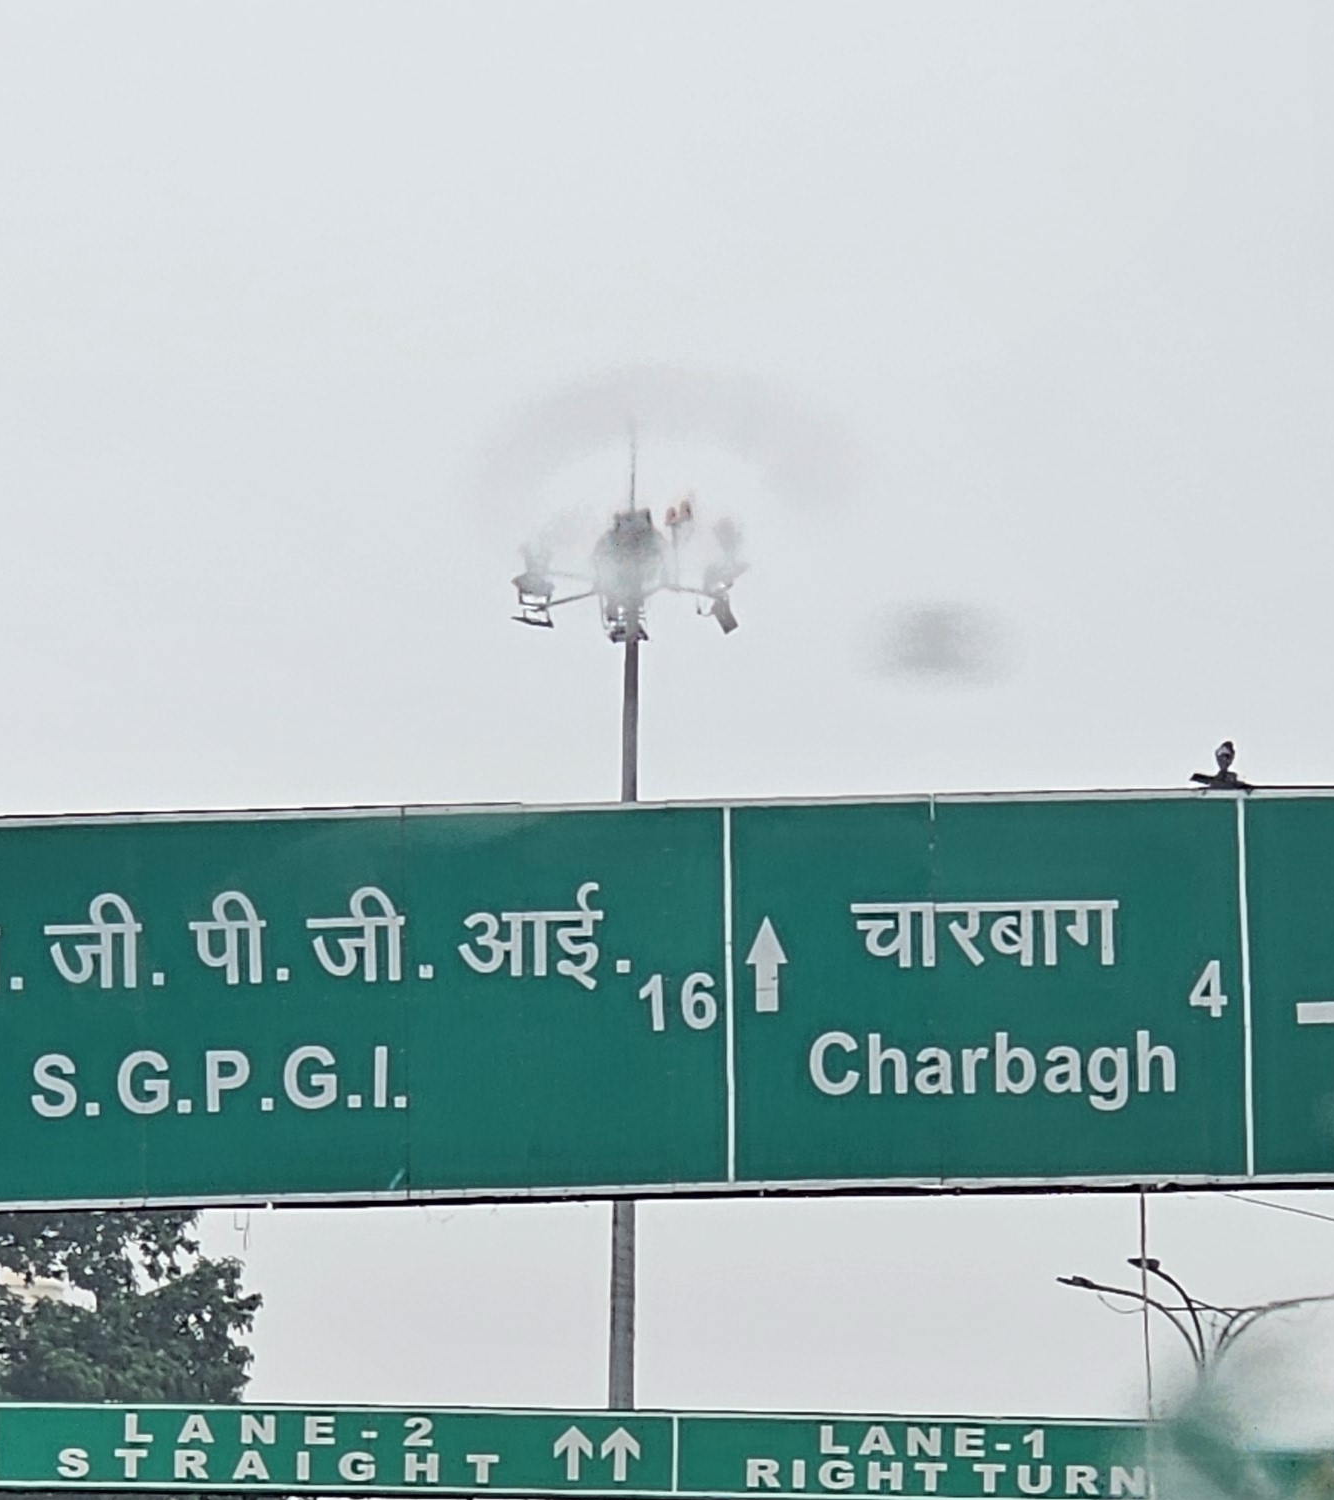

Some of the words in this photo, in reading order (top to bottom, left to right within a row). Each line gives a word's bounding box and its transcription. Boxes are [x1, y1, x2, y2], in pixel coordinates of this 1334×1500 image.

[45, 892, 165, 988] जी.
[189, 890, 291, 985] पी.
[307, 885, 435, 982] जी.
[851, 898, 1119, 968] चारबाग
[638, 971, 718, 1033] 16
[1189, 960, 1228, 1018] 4
[31, 1045, 408, 1118] S.G.P.G.I.
[809, 1029, 1177, 1111] Charbagh
[124, 1412, 434, 1447] LANE-2
[819, 1424, 1045, 1459] LANE-1
[57, 1447, 500, 1485] STRAIGHT
[746, 1458, 948, 1493] RIGHT
[973, 1463, 1147, 1495] TURN
